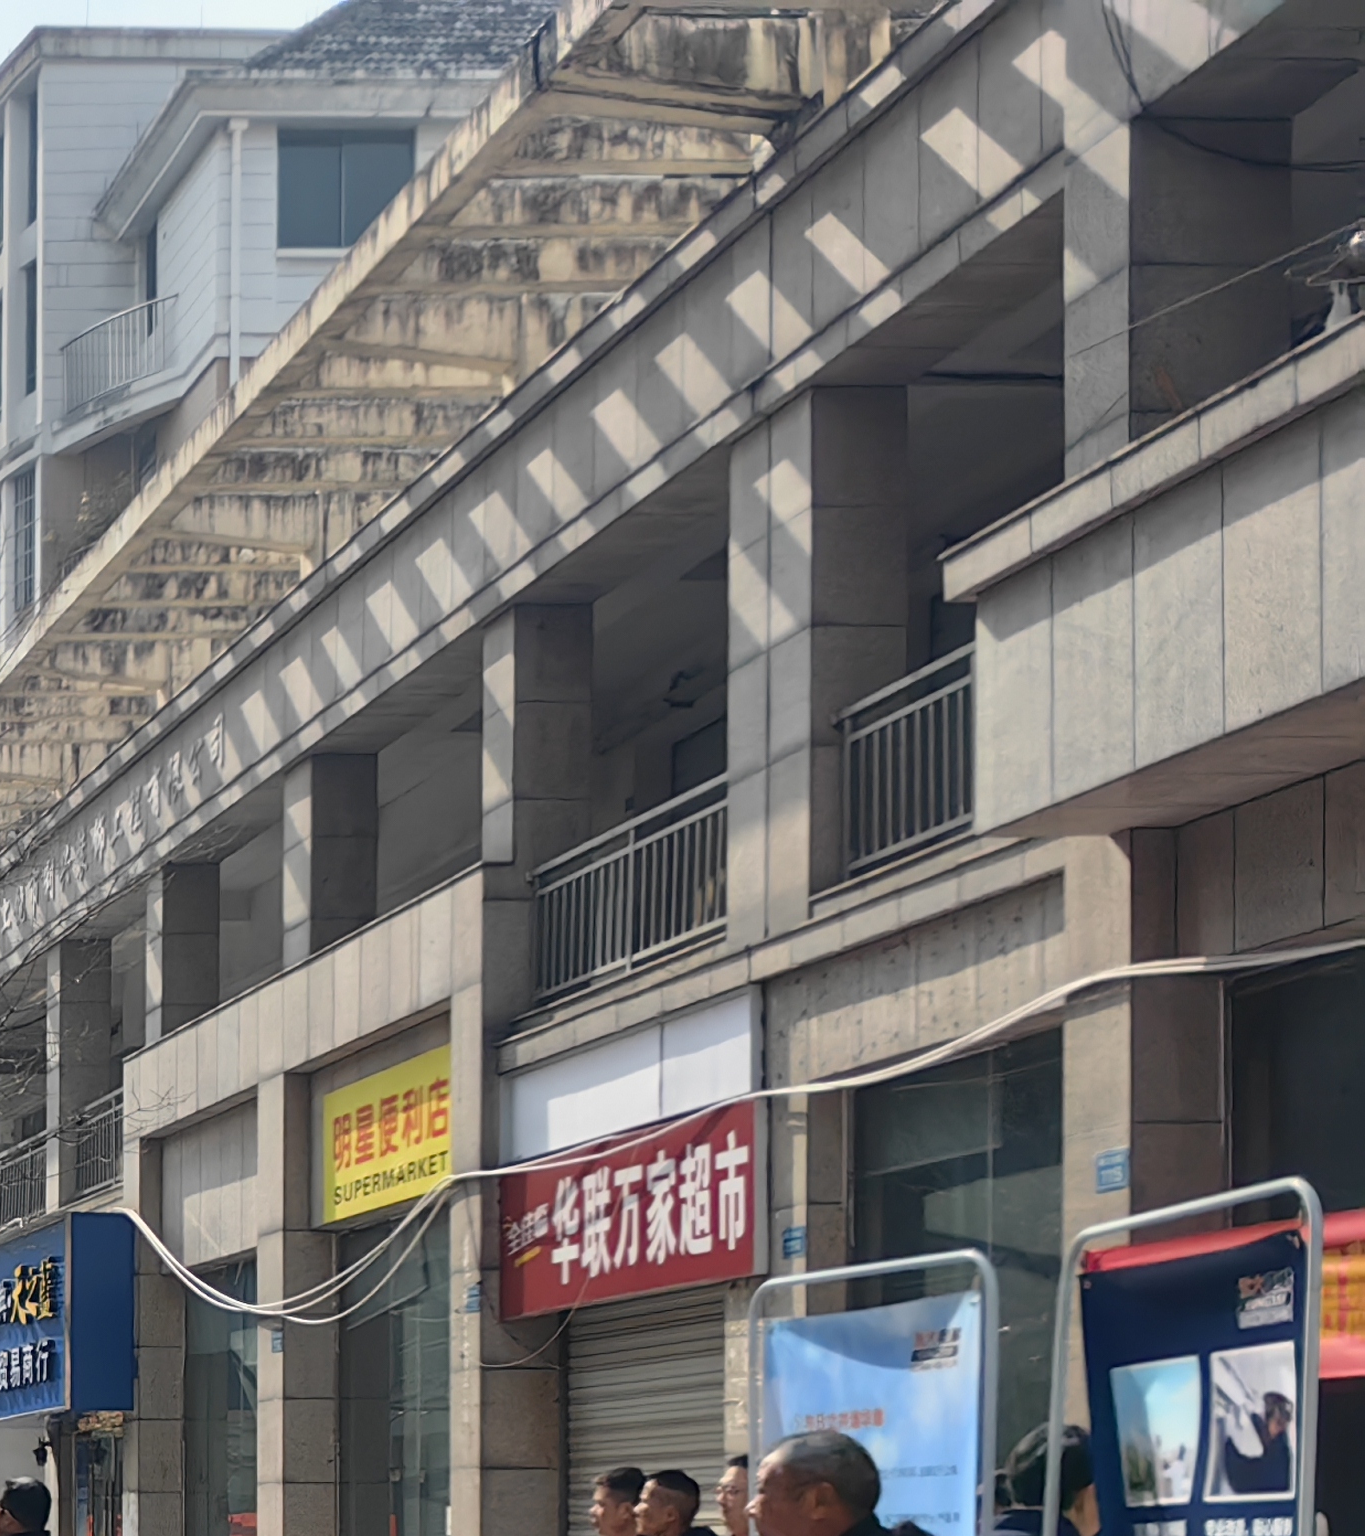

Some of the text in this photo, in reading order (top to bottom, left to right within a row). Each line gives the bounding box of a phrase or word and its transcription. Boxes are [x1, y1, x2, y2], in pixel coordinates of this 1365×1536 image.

[333, 1078, 450, 1172] 明星便利店
[334, 1150, 448, 1205] SUPERMARKET
[552, 1130, 750, 1286] 华联万家超市
